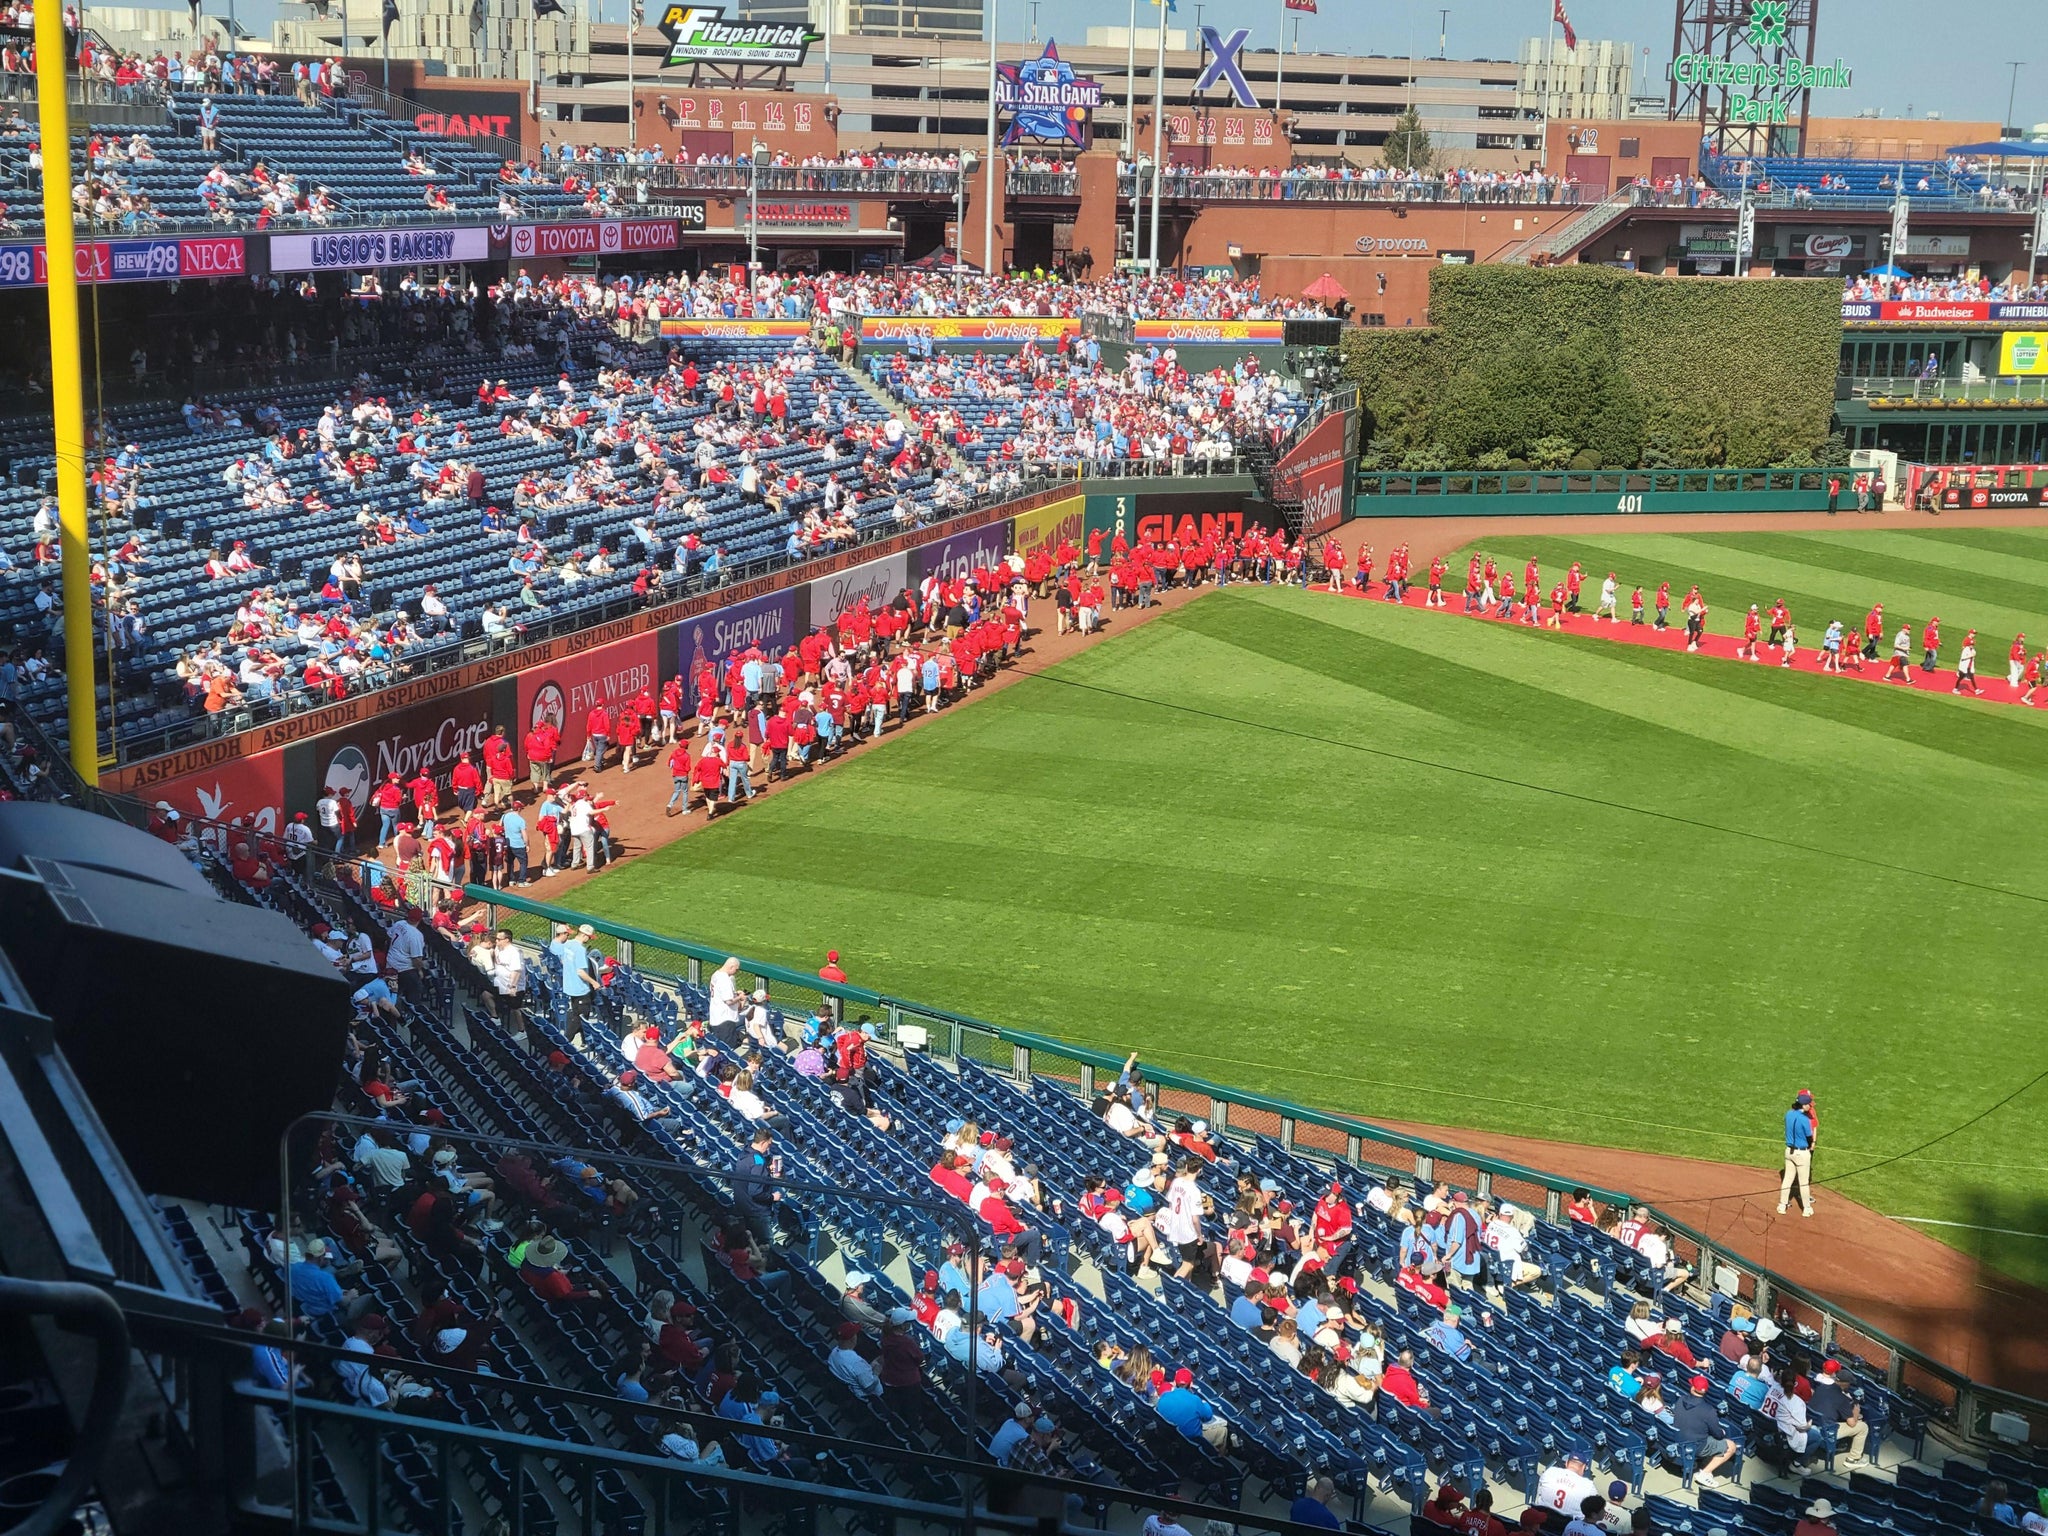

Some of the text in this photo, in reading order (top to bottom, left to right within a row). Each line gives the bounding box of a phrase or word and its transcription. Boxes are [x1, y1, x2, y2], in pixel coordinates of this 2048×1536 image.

[665, 8, 692, 24] PJ
[673, 9, 807, 46] Fitzpatrick
[676, 47, 796, 59] WINDOWS ROOFING SIDING BATHS
[1193, 26, 1260, 108] X
[1674, 54, 1851, 88] Citizens Bank
[995, 80, 1100, 106] ALL STAR GAME
[680, 98, 696, 119] P
[765, 102, 783, 122] 14
[794, 103, 811, 123] 15
[1729, 92, 1788, 123] Park
[414, 113, 511, 137] GIANT
[1172, 116, 1190, 136] 20
[1197, 117, 1216, 136] 32
[1226, 118, 1244, 137] 34
[1255, 119, 1273, 138] 36
[1579, 129, 1598, 147] 42
[793, 205, 850, 217] LUKE'S
[540, 229, 595, 250] TOYOTA
[626, 223, 675, 245] TOYOTA
[1377, 239, 1428, 250] TOYOTA
[184, 243, 244, 271] NECA
[311, 231, 456, 265] LISCIO'S BAKERY
[38, 249, 109, 279] NCA
[114, 252, 147, 270] IBEW
[154, 245, 178, 273] 98
[701, 321, 746, 337] Surfside
[874, 320, 931, 339] Surfside
[983, 320, 1038, 340] Surfside
[1167, 323, 1220, 341] Surfside
[998, 497, 1036, 518] ASPLUNDH
[1617, 495, 1643, 512] 401
[1991, 493, 2029, 503] TOYOTA
[951, 510, 990, 532] ASPLUNDH
[1137, 512, 1244, 543] GIANT
[900, 526, 943, 550] ASPLUNDH
[845, 541, 892, 568] ASPLUNDH
[785, 557, 836, 586] ASPLUNDH
[718, 577, 775, 606] ASPLUNDH
[645, 597, 708, 629] ASPLUNDH
[565, 617, 635, 654] ASPLUNDH
[713, 608, 783, 655] SHERWIN
[476, 644, 552, 682] ASPLUNDH
[603, 663, 650, 699] WEBB
[924, 670, 933, 678] 12
[375, 672, 461, 713] ASPLUNDH
[832, 699, 839, 708] 3
[262, 701, 359, 748] ASPLUNDH
[373, 717, 489, 786] NovaCare
[132, 737, 243, 788] ASPLUNDH
[321, 806, 327, 815] 3
[495, 842, 502, 852] 3
[1621, 1228, 1636, 1245] 10
[1761, 1397, 1778, 1417] 28
[1553, 1489, 1566, 1509] 3
